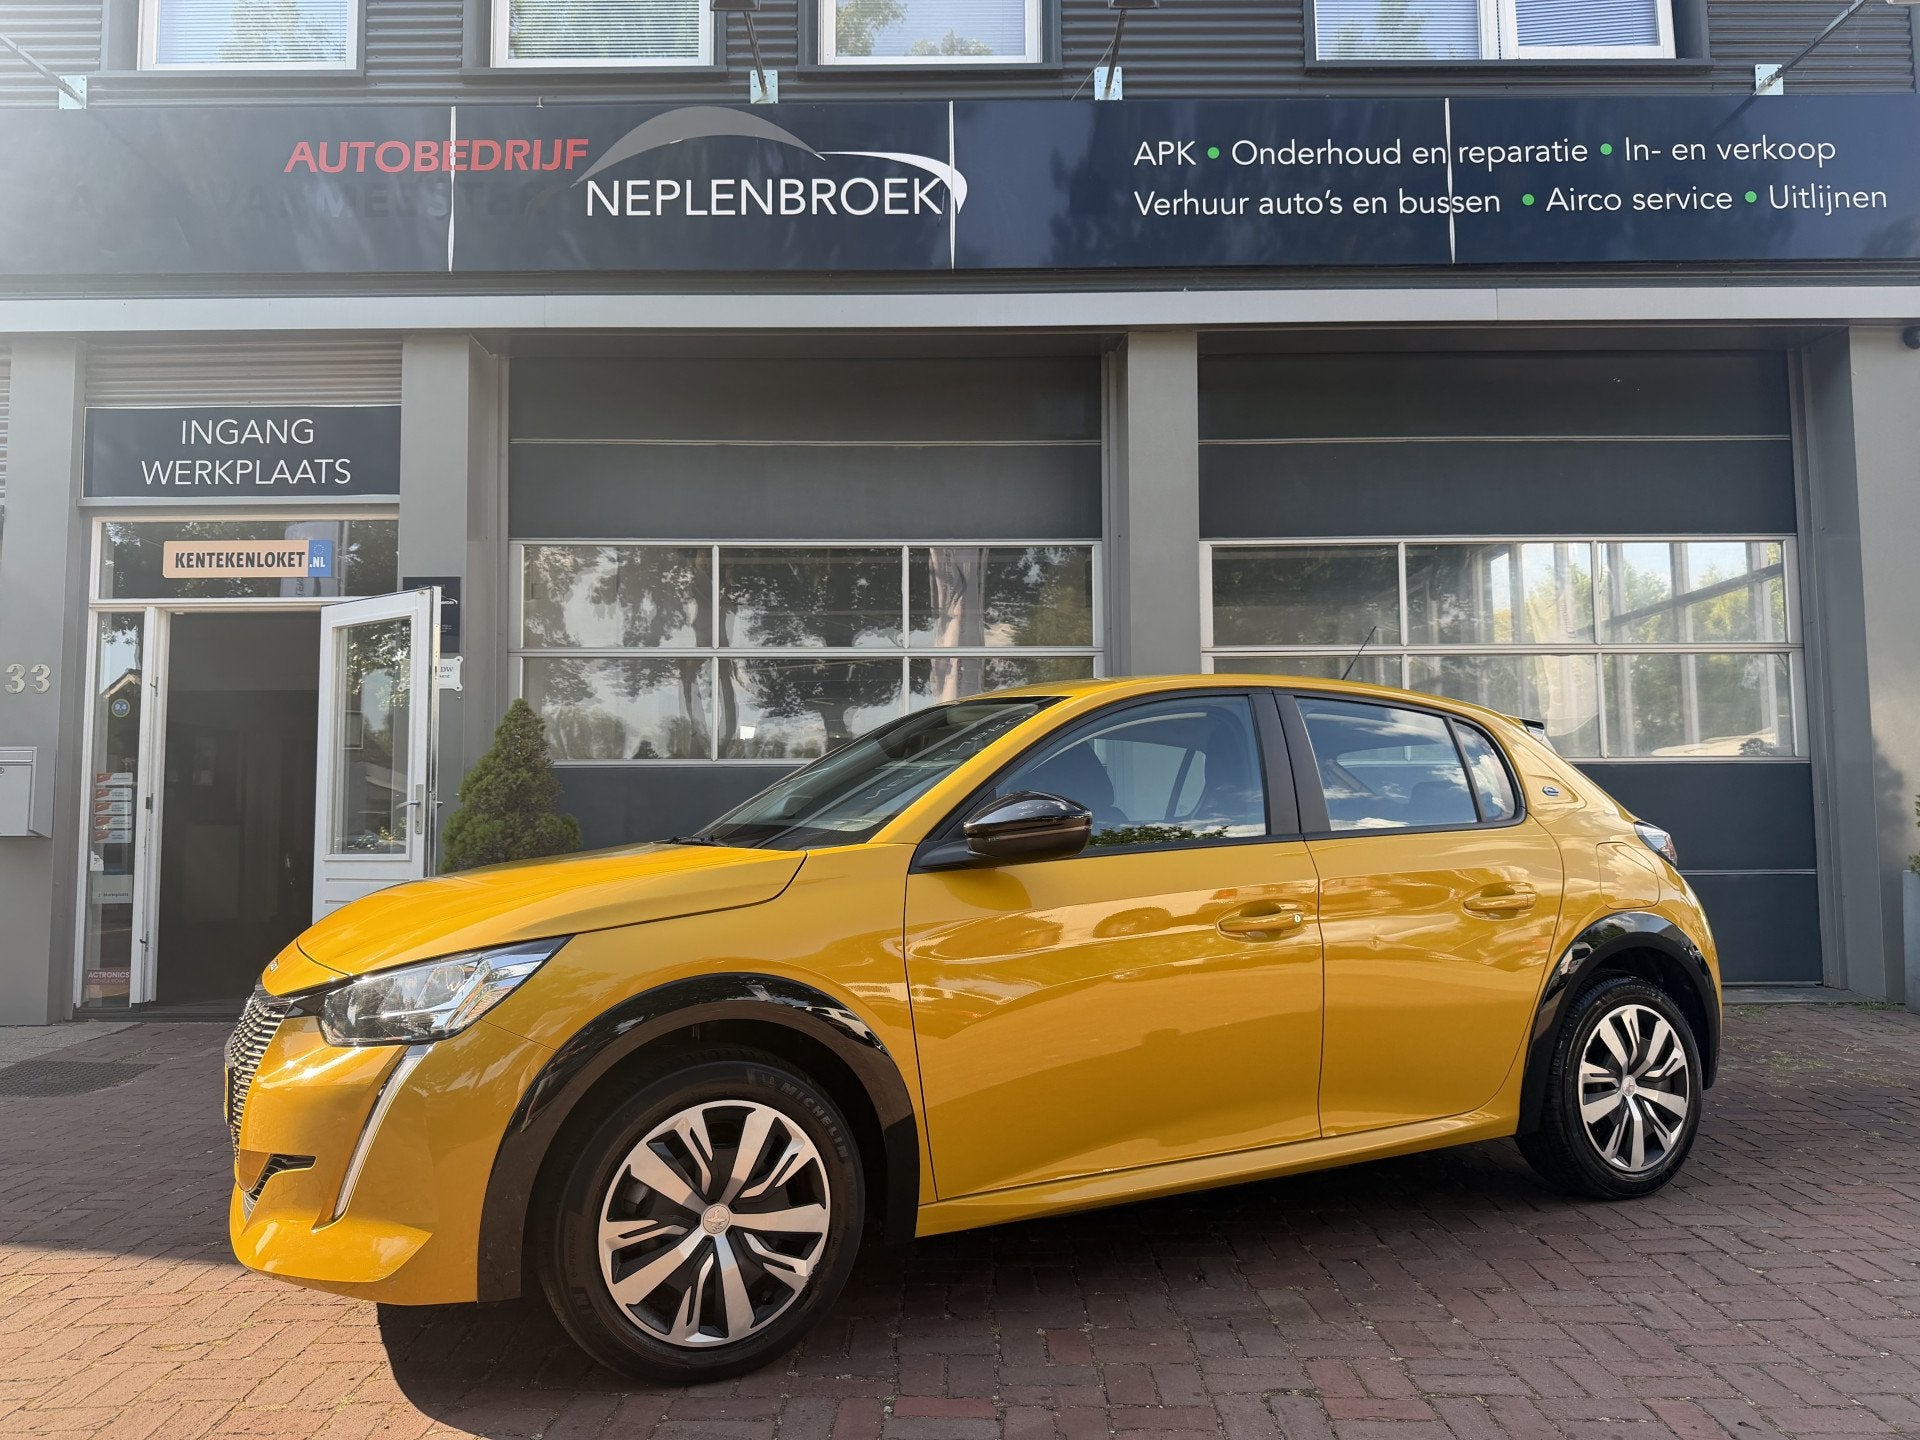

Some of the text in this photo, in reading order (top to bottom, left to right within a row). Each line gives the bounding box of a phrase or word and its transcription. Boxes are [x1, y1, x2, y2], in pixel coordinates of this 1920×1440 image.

[284, 138, 589, 173] AUTOBEDRIJF
[1133, 134, 1836, 171] APK Onderhoud en reparatie In- en verkoop
[587, 177, 942, 217] NEPLENBROEK
[1133, 188, 1250, 217] Verhuur
[1352, 196, 1387, 215] en
[1398, 188, 1501, 215] bussen
[1545, 187, 1622, 212] Airco
[1632, 185, 1733, 211] service
[1768, 183, 1887, 216] Uitlijnen
[180, 418, 315, 446] INGANG
[140, 457, 352, 486] WERKPLAATS
[175, 551, 306, 569] KENTEKENLOKET
[5, 663, 51, 694] 33
[88, 971, 130, 979] ACTRONICS
[779, 1081, 849, 1158] MICHELIN
